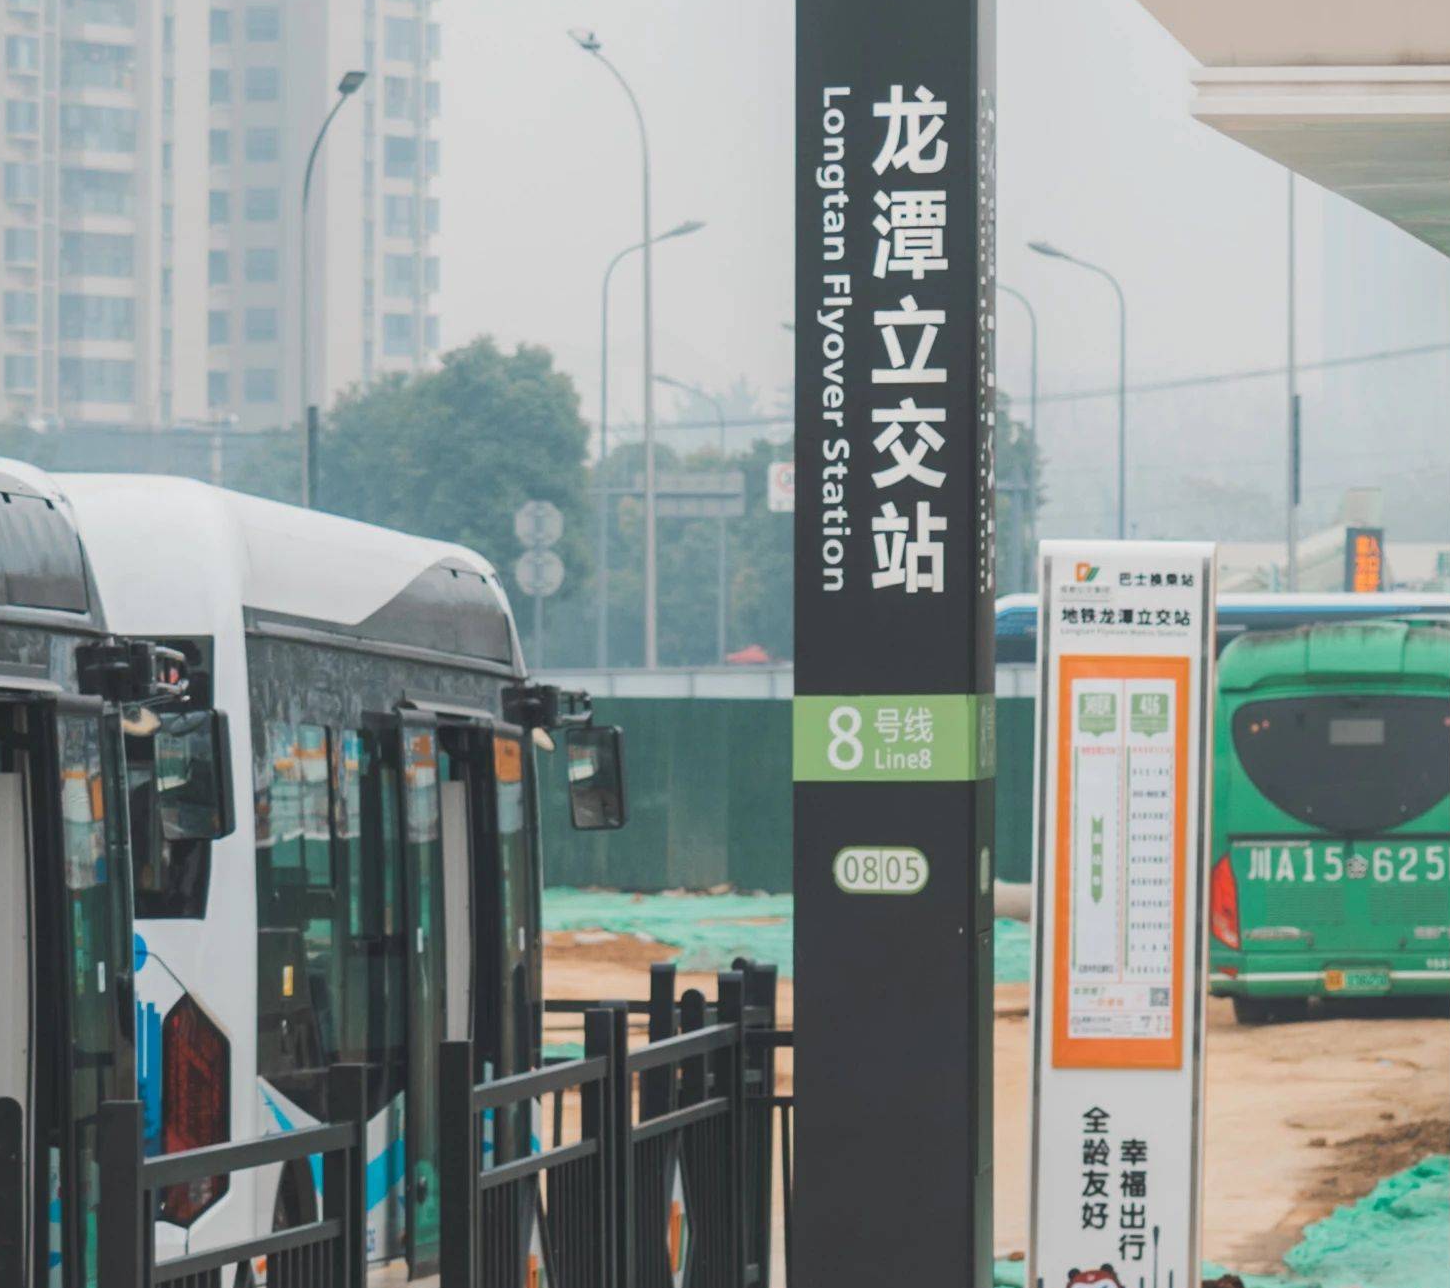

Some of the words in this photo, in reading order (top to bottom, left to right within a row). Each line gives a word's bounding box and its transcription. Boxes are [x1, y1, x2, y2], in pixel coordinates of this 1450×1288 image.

[816, 86, 851, 261] Longtan
[816, 274, 853, 428] Flyover
[872, 84, 949, 594] 龙潭立交站
[822, 438, 852, 592] Station
[1061, 608, 1190, 626] 地铁龙潭立交站
[827, 706, 864, 771] 8
[874, 707, 935, 744] 号线
[874, 747, 933, 771] Line8
[1081, 1106, 1111, 1230] 全龄友好
[1118, 1138, 1148, 1261] 幸福出行
